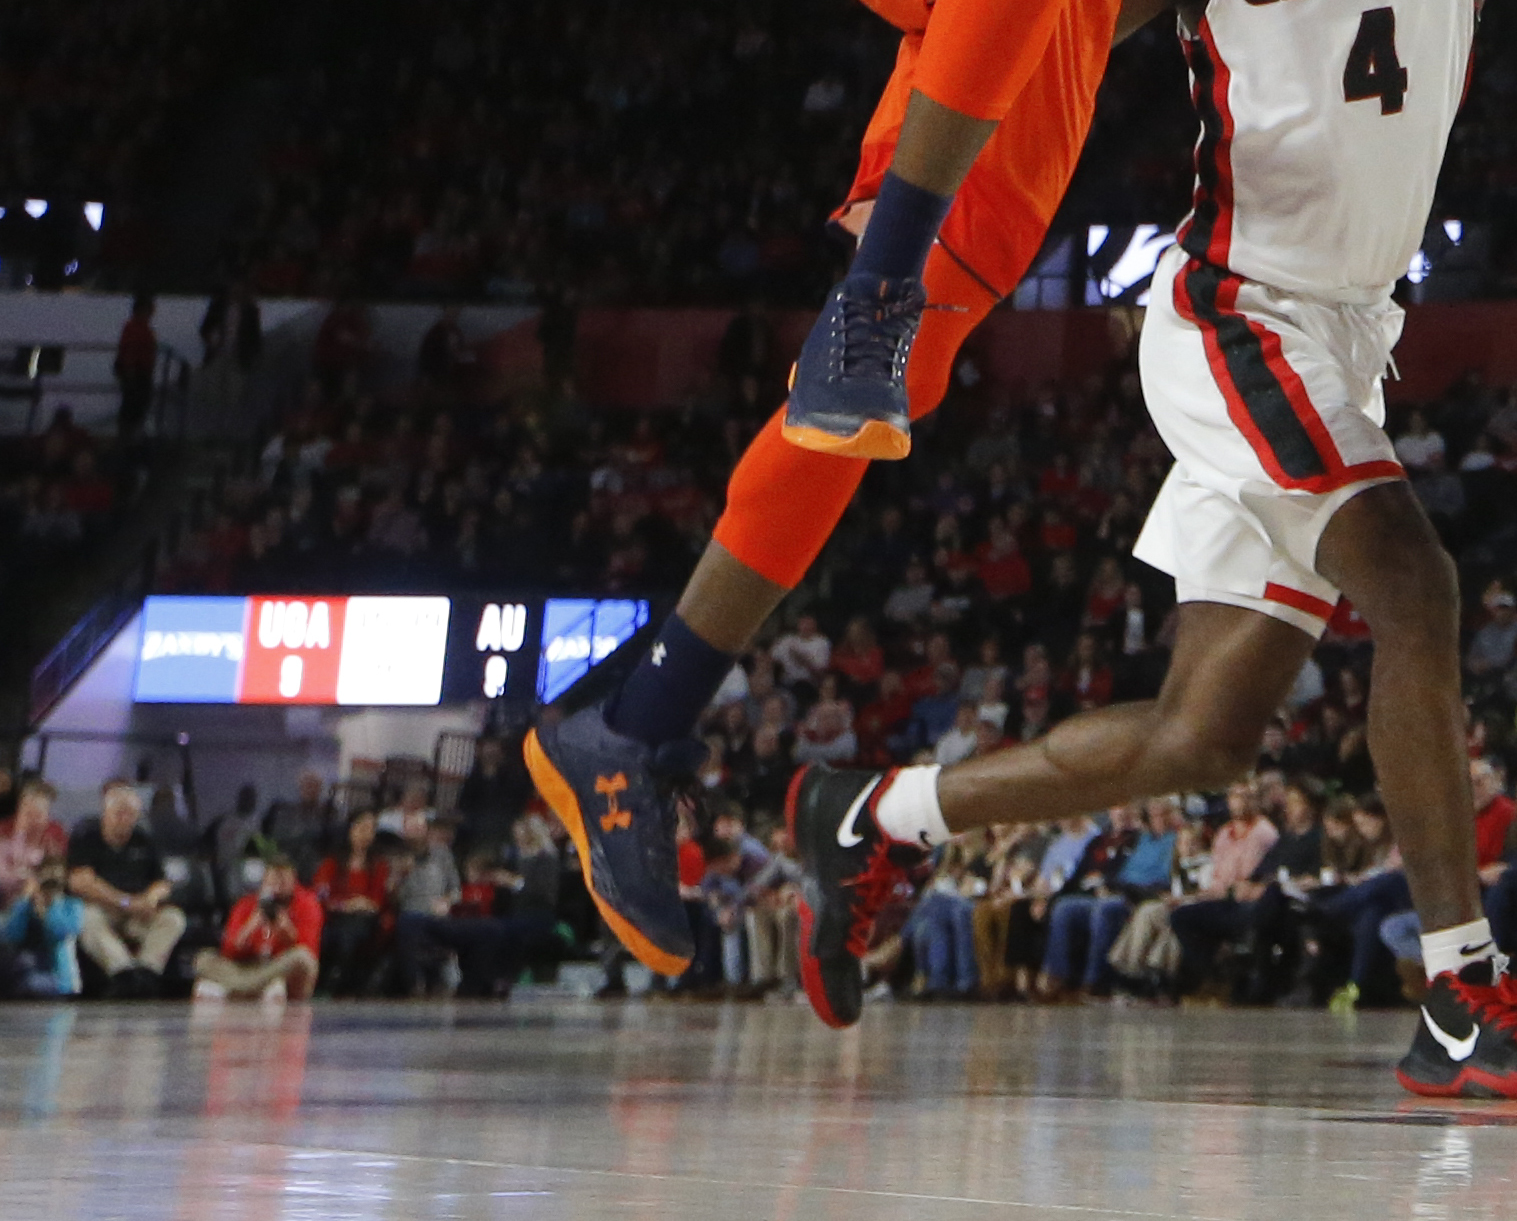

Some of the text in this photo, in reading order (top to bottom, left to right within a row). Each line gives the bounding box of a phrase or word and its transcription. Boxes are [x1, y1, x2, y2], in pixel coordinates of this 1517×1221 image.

[1342, 6, 1409, 117] 4
[258, 600, 331, 650] UGA
[476, 603, 528, 652] AU
